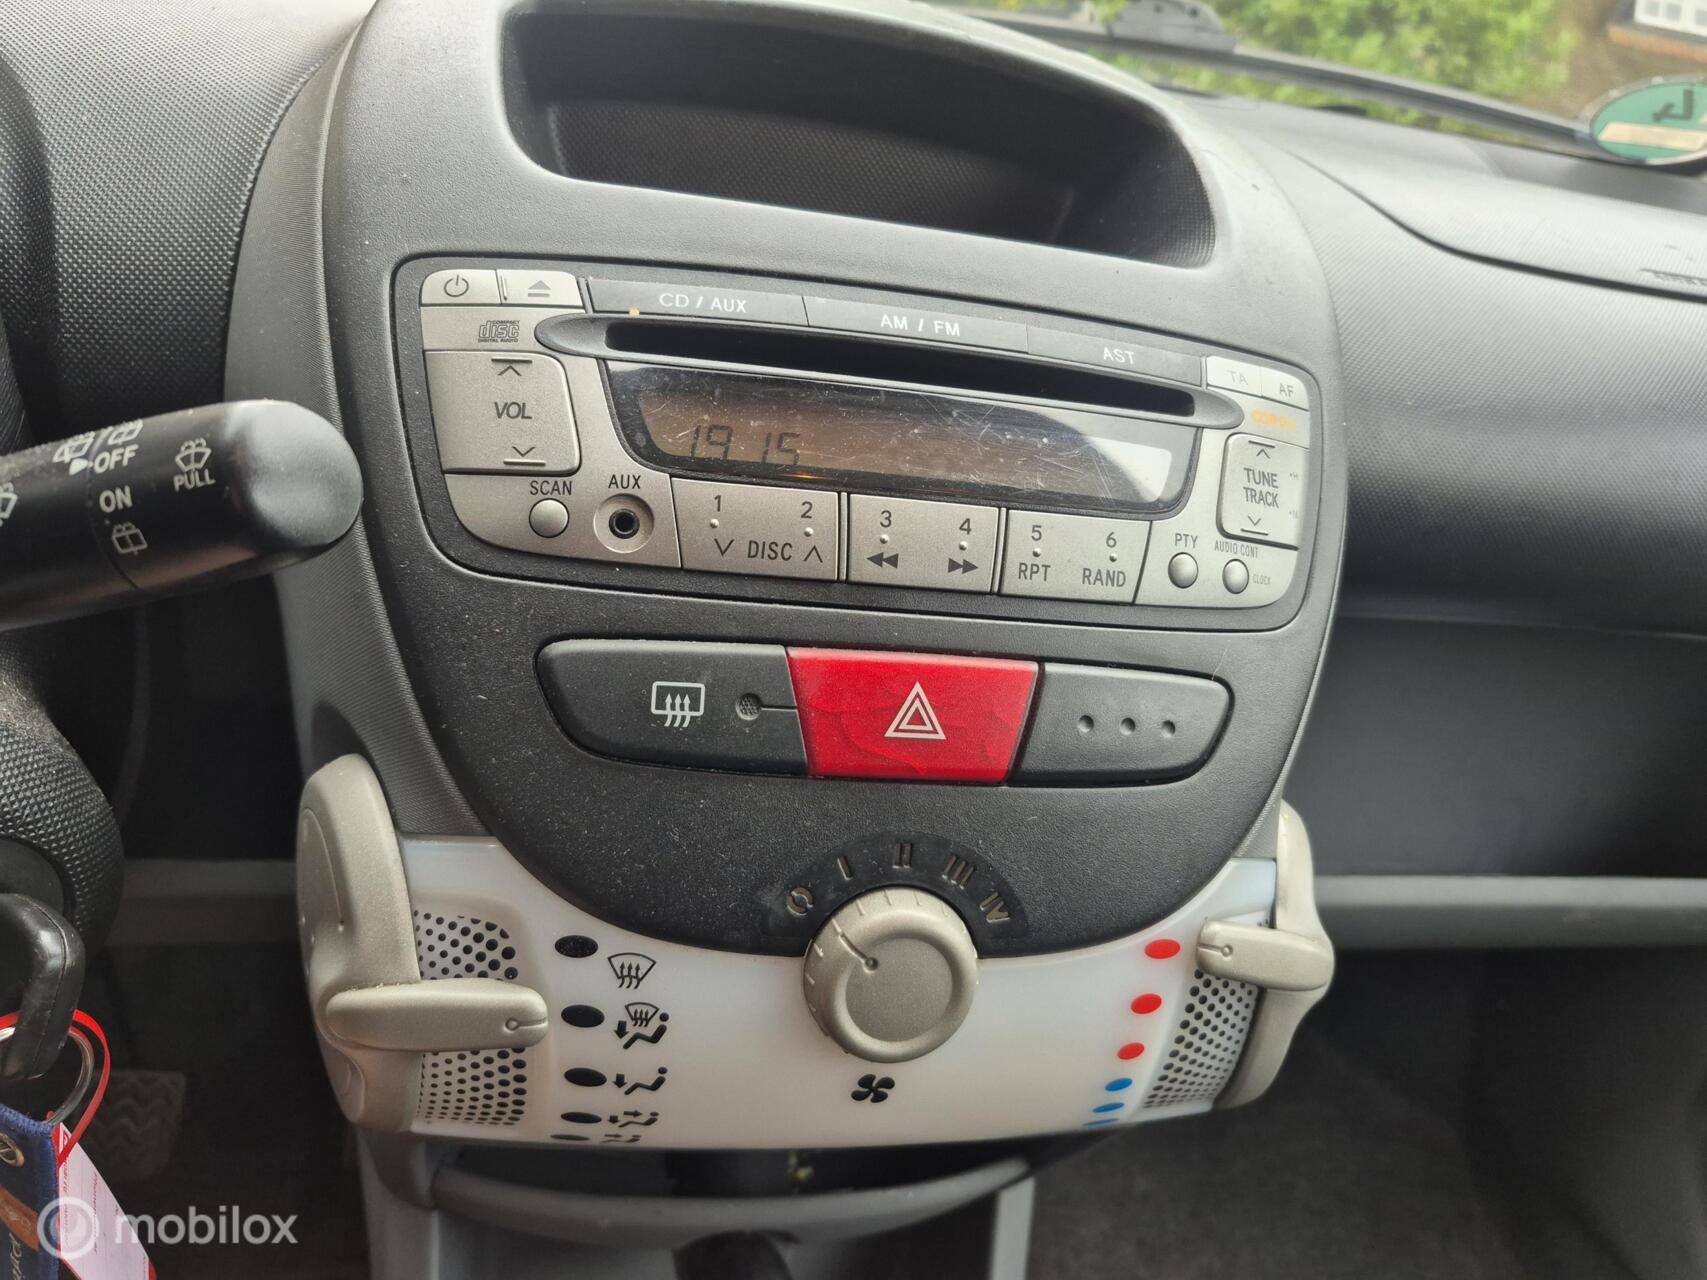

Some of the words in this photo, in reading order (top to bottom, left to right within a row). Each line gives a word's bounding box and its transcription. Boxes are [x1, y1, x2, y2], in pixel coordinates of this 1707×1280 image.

[659, 292, 690, 309] CD
[710, 298, 747, 314] AUX
[880, 313, 908, 331] AM
[933, 320, 960, 337] FM
[1103, 346, 1136, 366] AST
[1227, 368, 1249, 386] TA
[1279, 383, 1295, 398] AF
[494, 402, 533, 421] VOL
[93, 445, 139, 474] OFF
[173, 468, 216, 492] PULL
[608, 474, 642, 491] AUX
[1243, 467, 1279, 489] TUNE
[529, 480, 573, 497] SCAN
[1243, 486, 1280, 509] TRACK
[99, 486, 133, 513] ON
[714, 494, 722, 512] 1
[800, 501, 813, 519] 2
[879, 510, 892, 528] 3
[958, 518, 972, 535] 4
[1030, 525, 1042, 542] 5
[747, 539, 793, 561] DISC
[1106, 532, 1117, 549] 6
[1174, 532, 1198, 549] PTY
[1214, 540, 1238, 555] AUDIO
[1240, 544, 1259, 559] CONT
[1017, 562, 1051, 582] RPT
[1082, 567, 1127, 587] RAND
[1252, 573, 1271, 586] CLOCK
